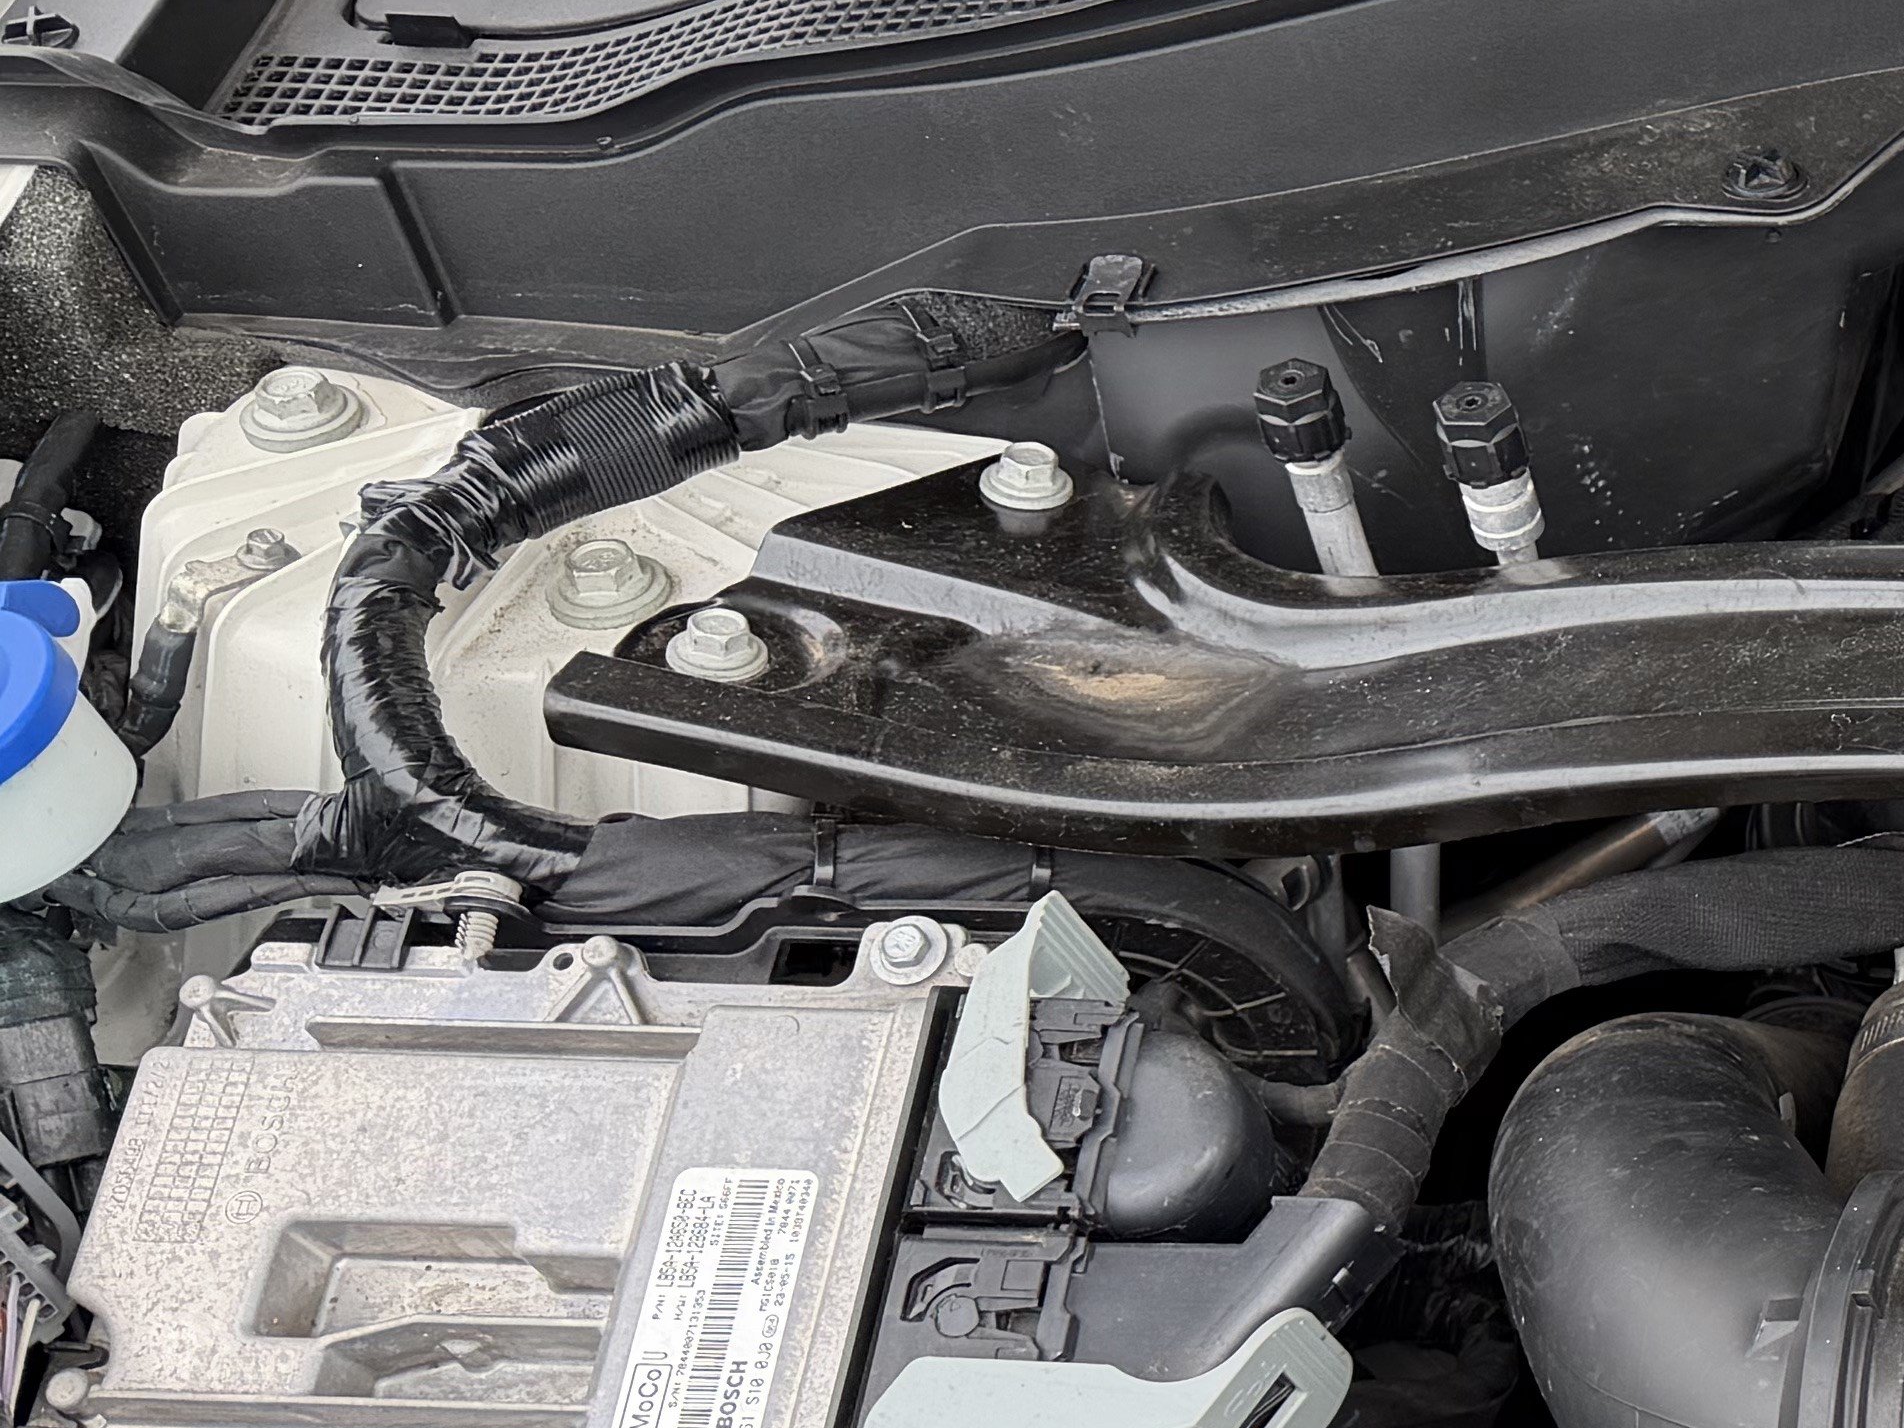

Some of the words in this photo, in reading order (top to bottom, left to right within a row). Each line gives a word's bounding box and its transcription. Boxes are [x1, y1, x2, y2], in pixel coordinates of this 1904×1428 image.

[246, 1068, 299, 1174] BOSCH
[709, 1214, 723, 1246] SITE:
[751, 1227, 770, 1286] Assembled
[767, 1177, 786, 1215] Mexico
[652, 1293, 666, 1320] P/N:
